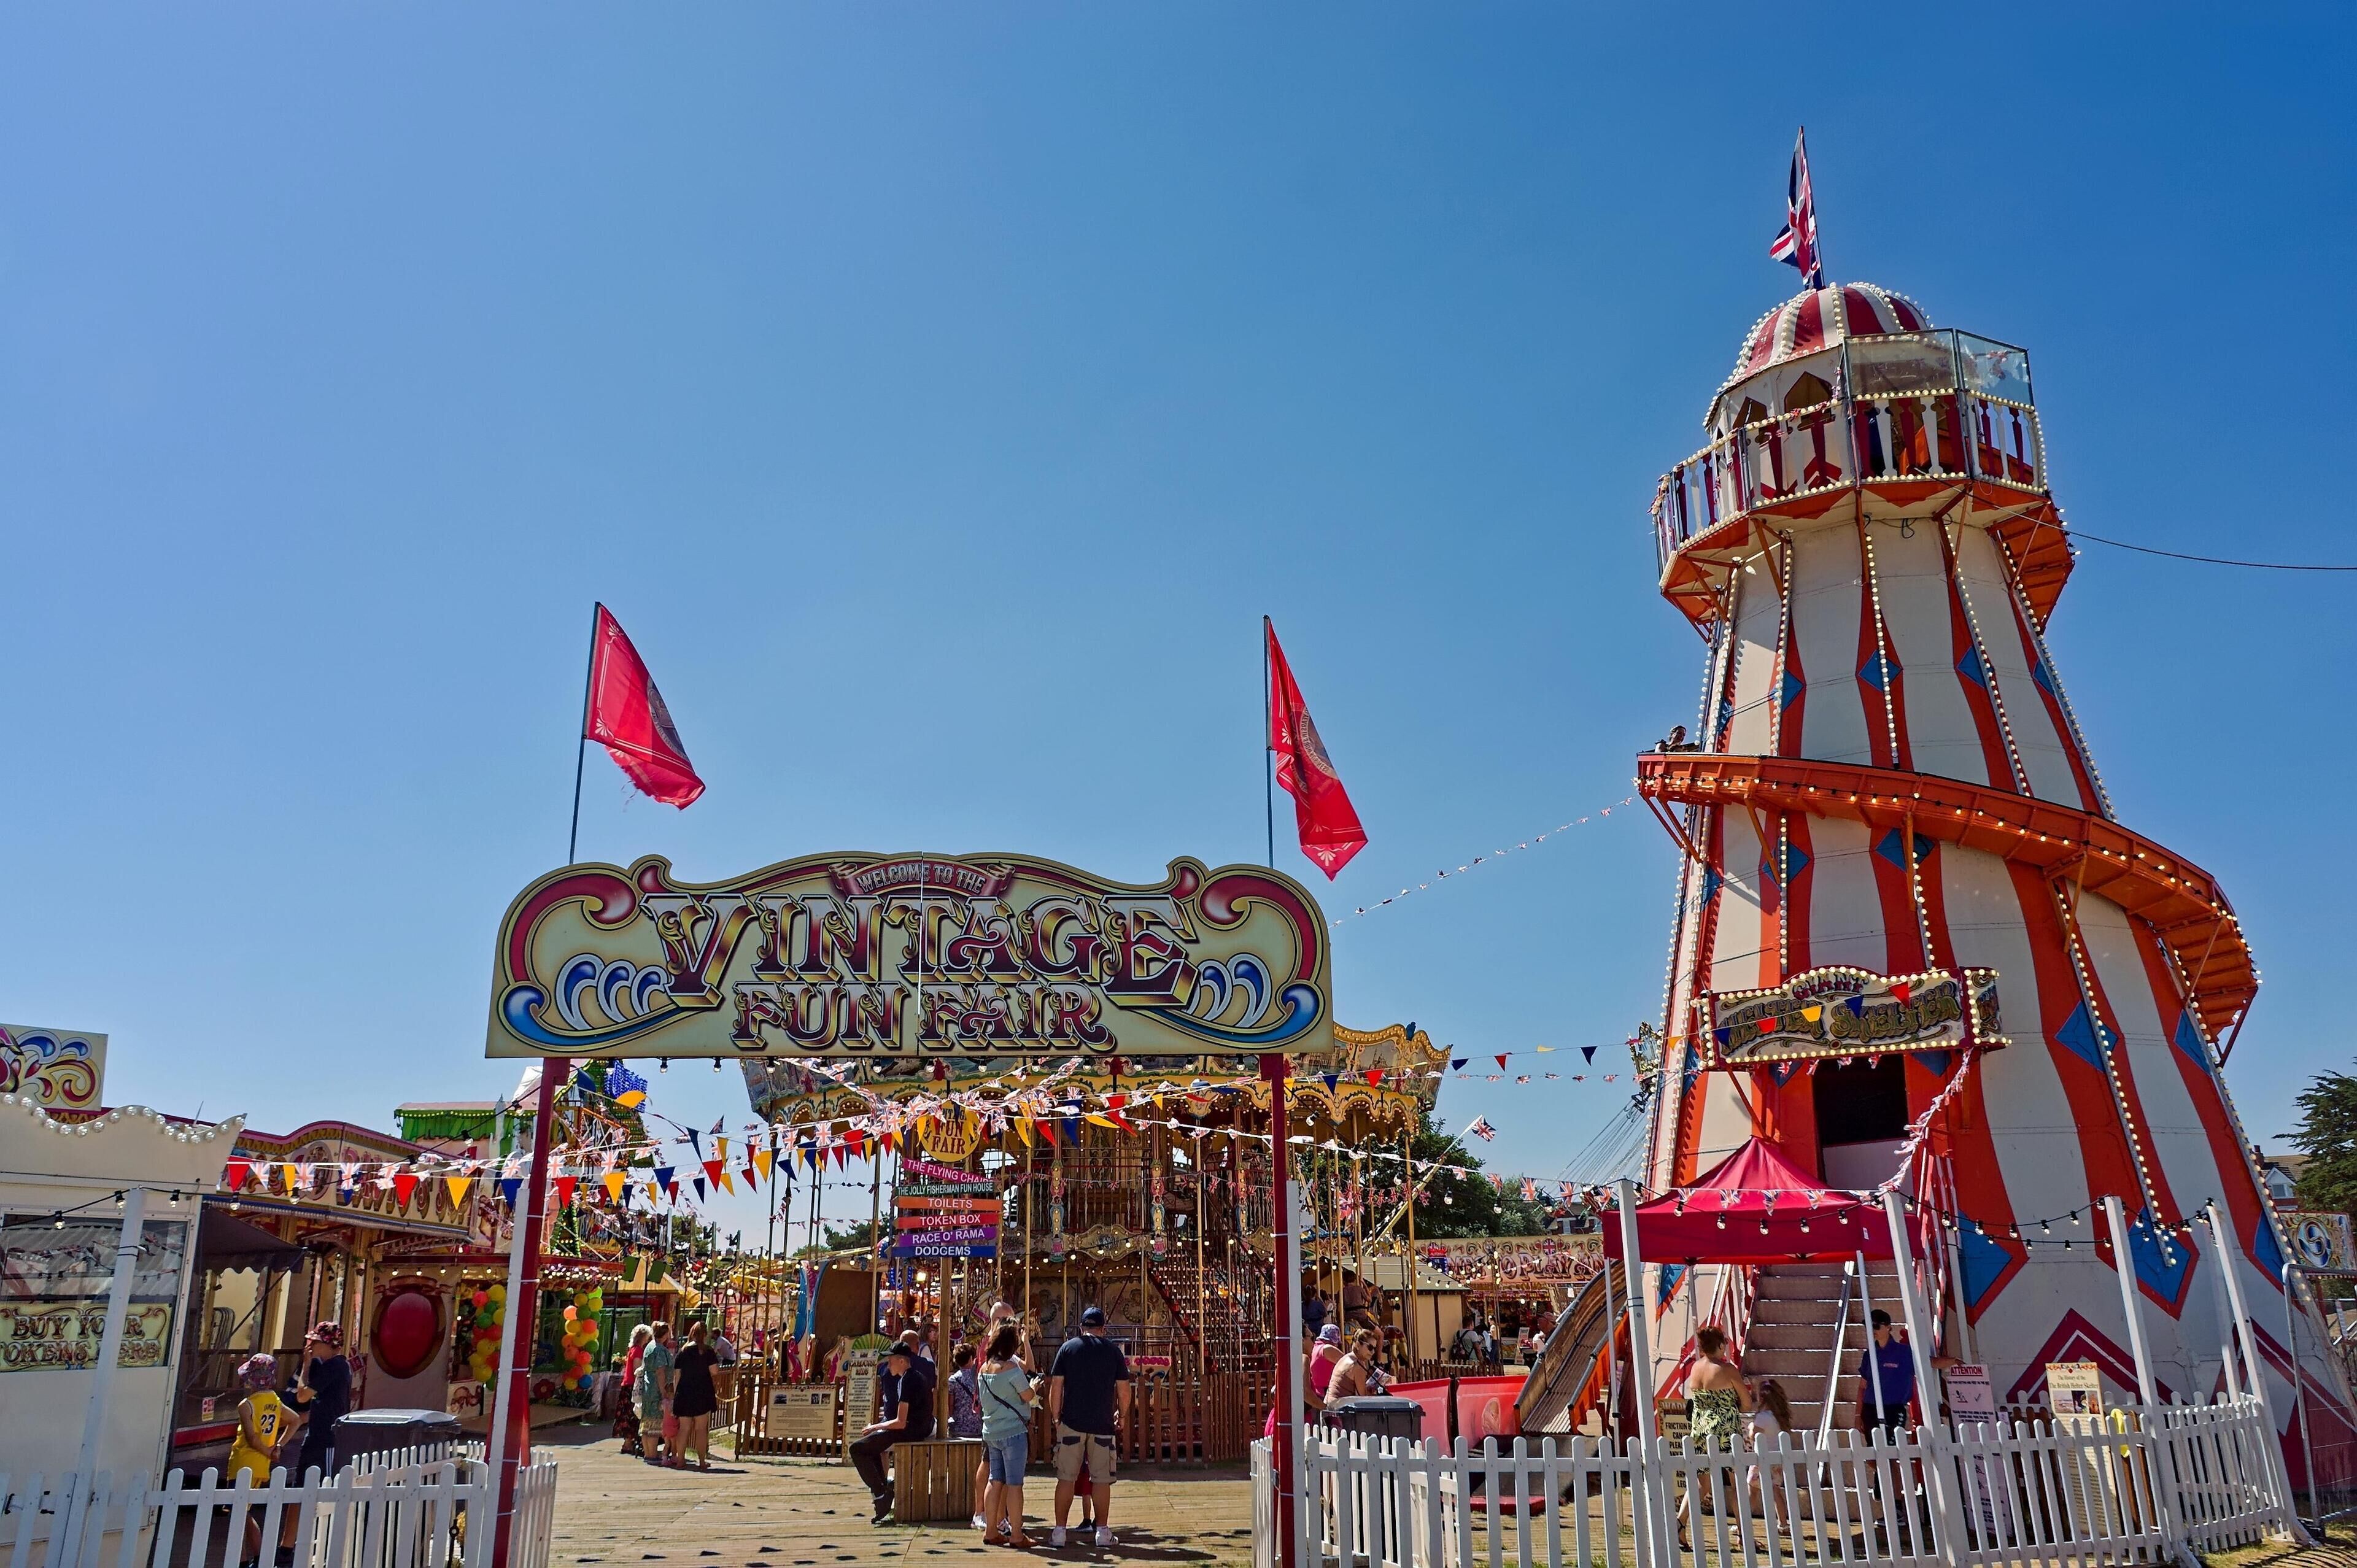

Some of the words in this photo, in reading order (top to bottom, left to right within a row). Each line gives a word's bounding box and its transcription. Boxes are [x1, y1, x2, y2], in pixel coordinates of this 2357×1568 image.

[857, 863, 931, 893] WELCOME
[933, 864, 954, 884] TO
[956, 869, 988, 894] THE
[640, 893, 1198, 1008] VINTAGE
[1792, 971, 1870, 1000] GIANT
[729, 982, 911, 1049] FUN
[916, 981, 1118, 1051] FAIR
[1830, 981, 1962, 1043] SKELTER
[931, 1136, 966, 1154] FAIR
[907, 1159, 926, 1172] THE
[927, 1165, 959, 1180] FLYING
[898, 1187, 909, 1195] THE
[909, 1186, 926, 1195] JOLLY
[927, 1184, 959, 1195] FISHERMAN
[961, 1183, 973, 1193] FUN
[973, 1183, 993, 1192] HOUSE
[928, 1198, 973, 1208] TOILETS
[919, 1216, 956, 1226] TOKEN
[959, 1214, 981, 1224] BOX
[912, 1233, 940, 1244] RACE
[943, 1232, 953, 1241] O'
[956, 1229, 985, 1240] RAMA
[915, 1246, 971, 1256] DODGEMS
[1518, 1252, 1572, 1281] PLAY
[1574, 1251, 1604, 1281] AN
[11, 1315, 72, 1340] BUY
[77, 1315, 145, 1340] YOR
[0, 1340, 92, 1366] OKENS
[95, 1339, 161, 1367] ERE
[1951, 1366, 1983, 1375] ATTENTION
[261, 1414, 276, 1434] 23
